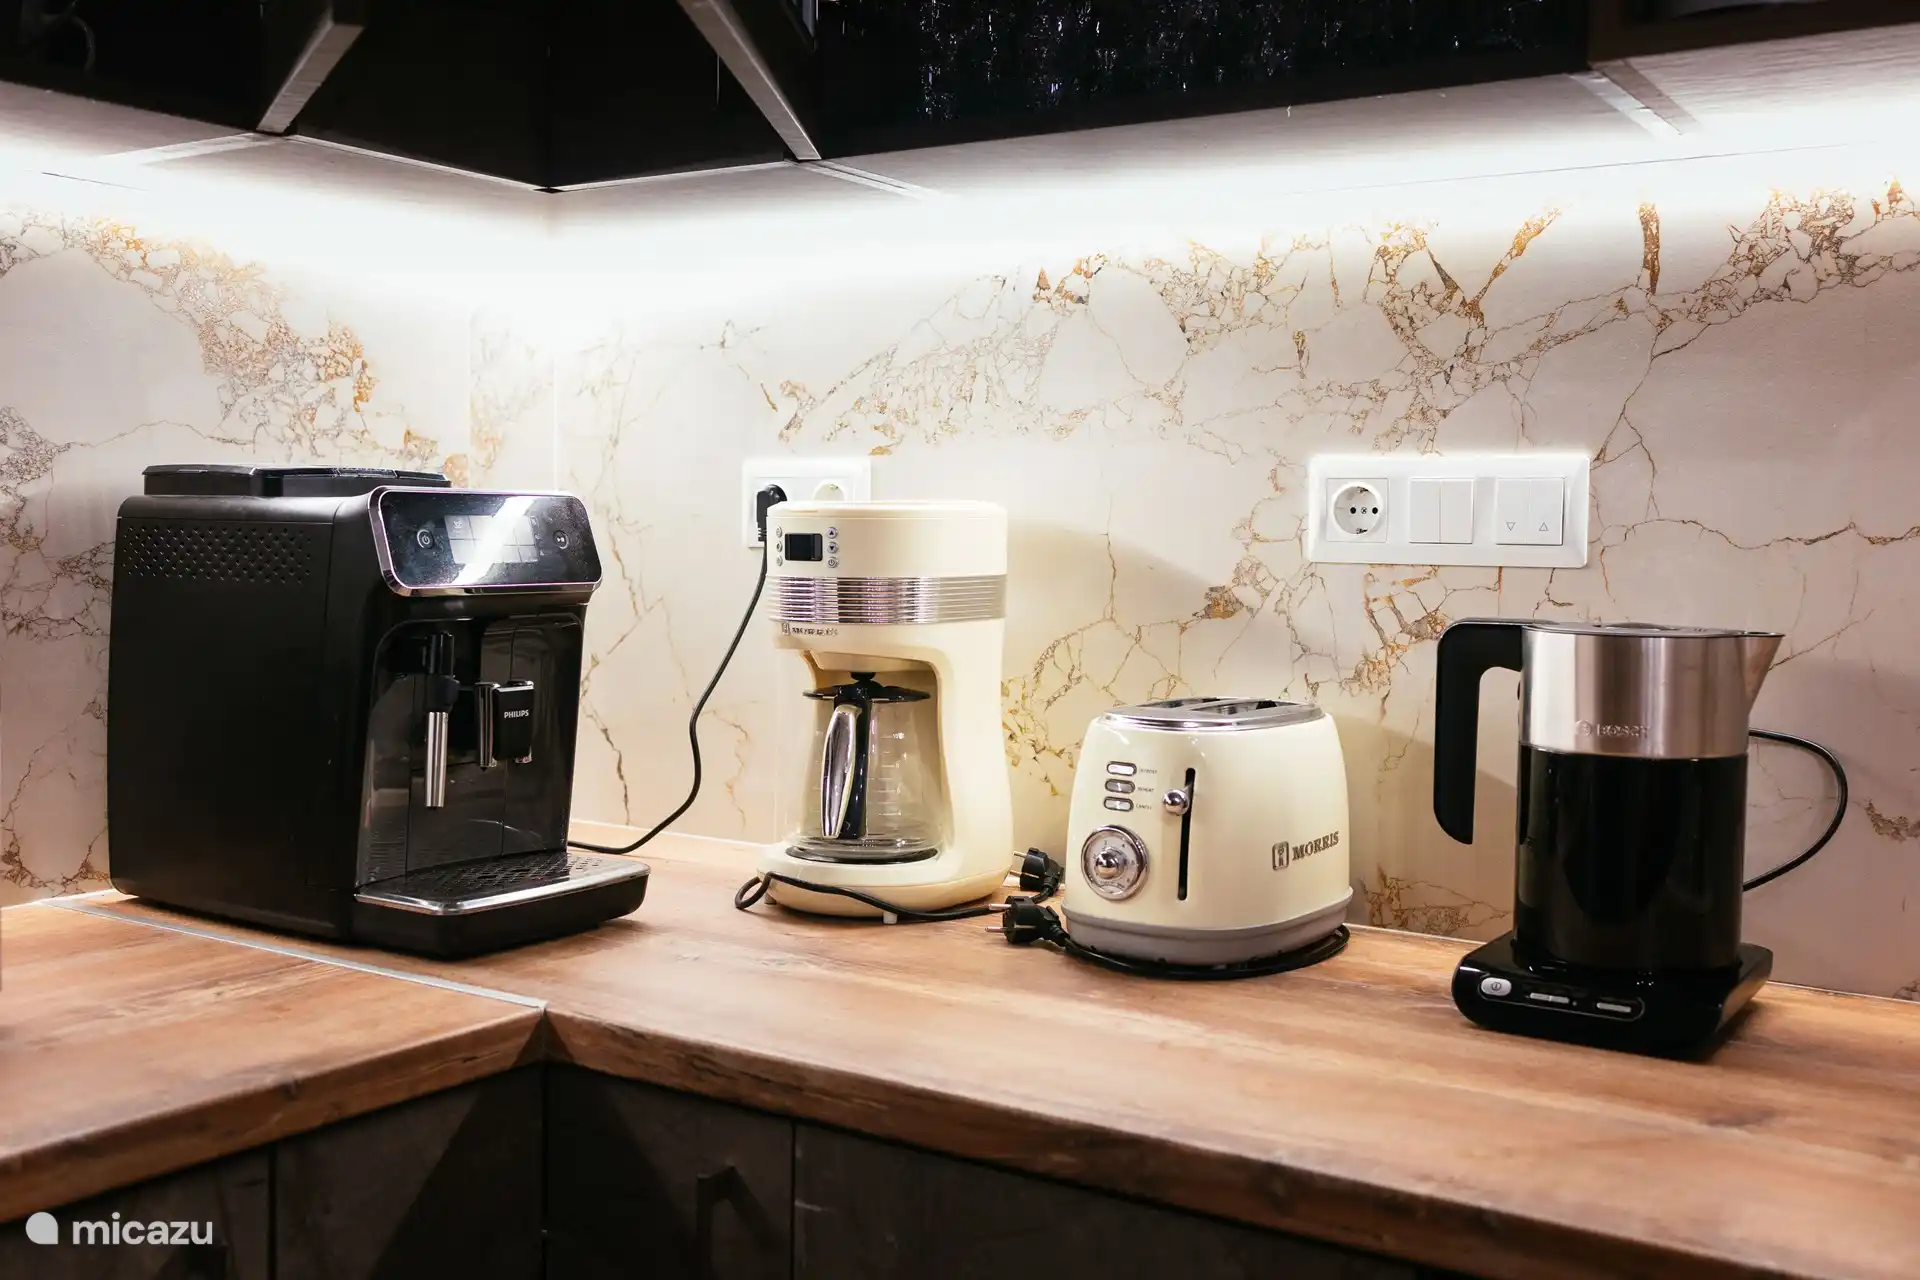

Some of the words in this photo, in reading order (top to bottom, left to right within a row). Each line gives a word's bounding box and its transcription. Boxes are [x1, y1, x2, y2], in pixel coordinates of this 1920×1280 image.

[503, 709, 530, 719] PHILIPS
[1596, 723, 1650, 739] BOSCH
[1291, 830, 1339, 861] MORRIS
